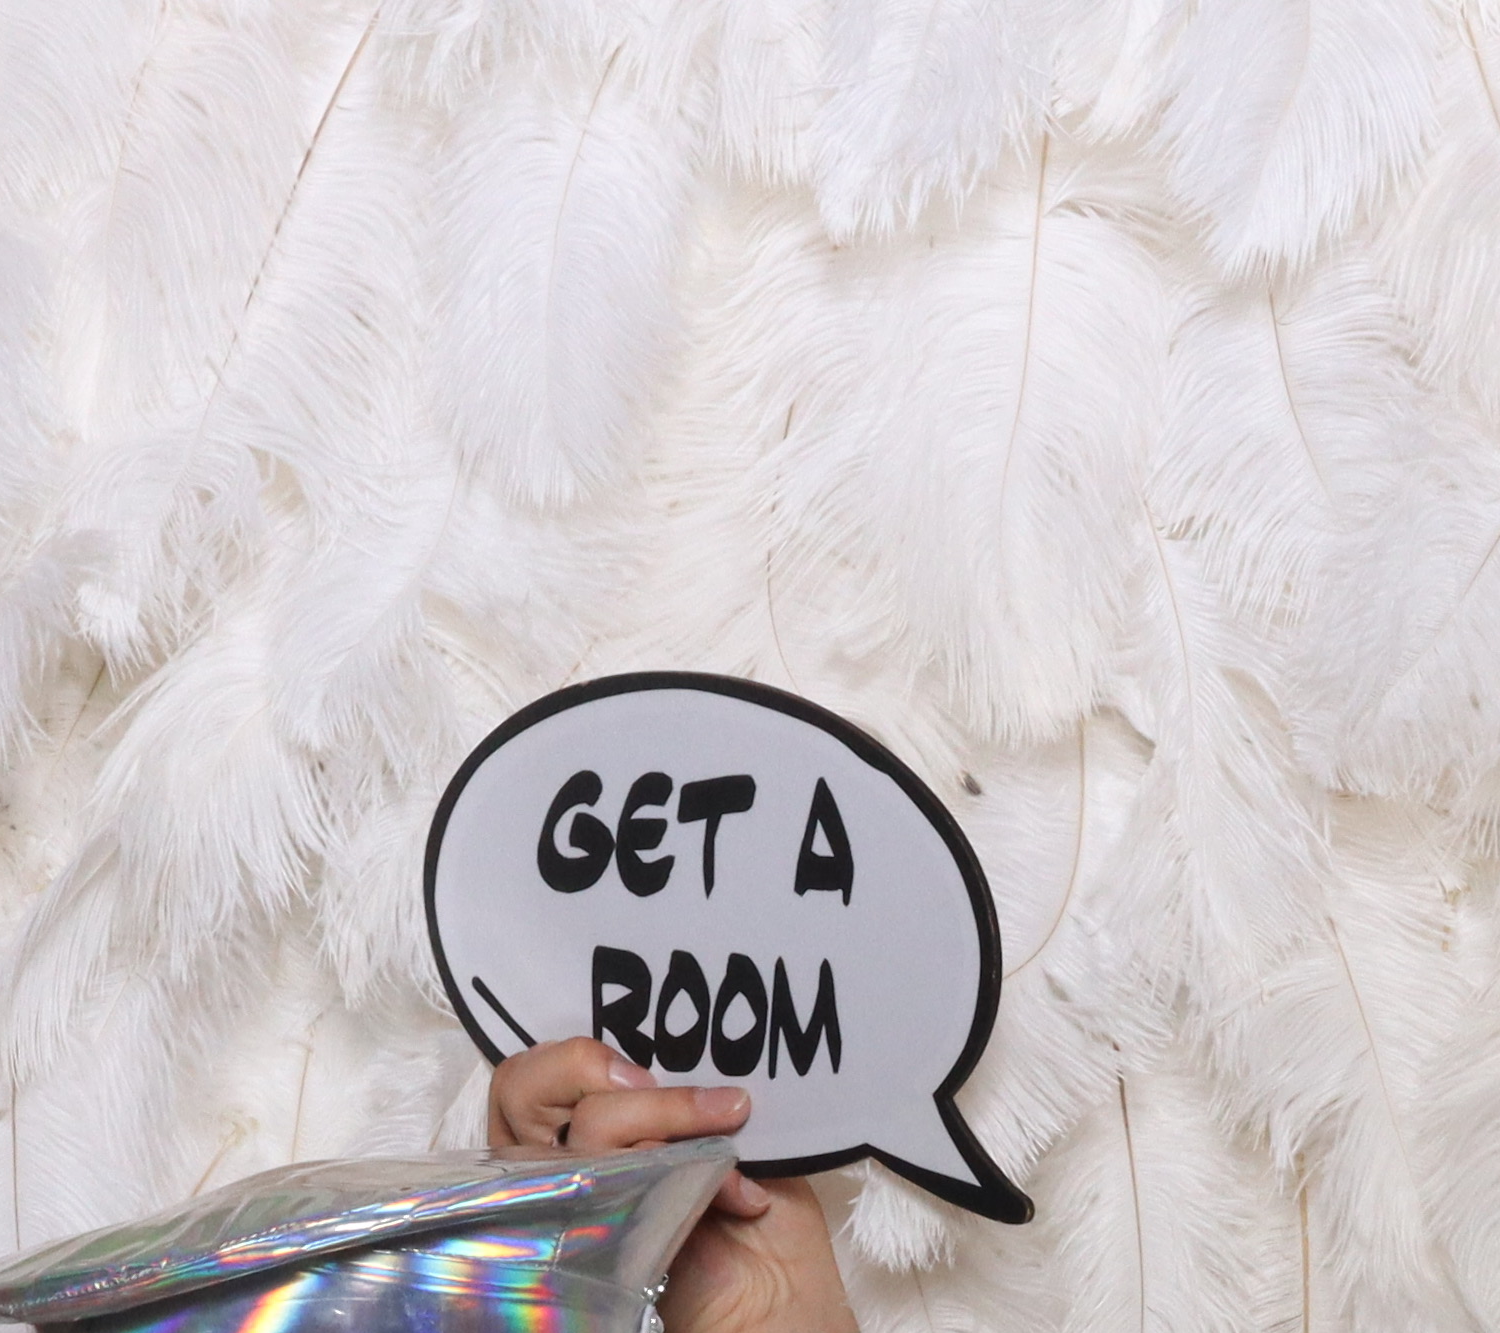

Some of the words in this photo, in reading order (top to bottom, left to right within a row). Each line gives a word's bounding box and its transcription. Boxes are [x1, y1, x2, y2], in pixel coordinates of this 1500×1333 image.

[536, 769, 757, 899] GET
[793, 777, 856, 907] A
[591, 945, 843, 1080] ROOM
